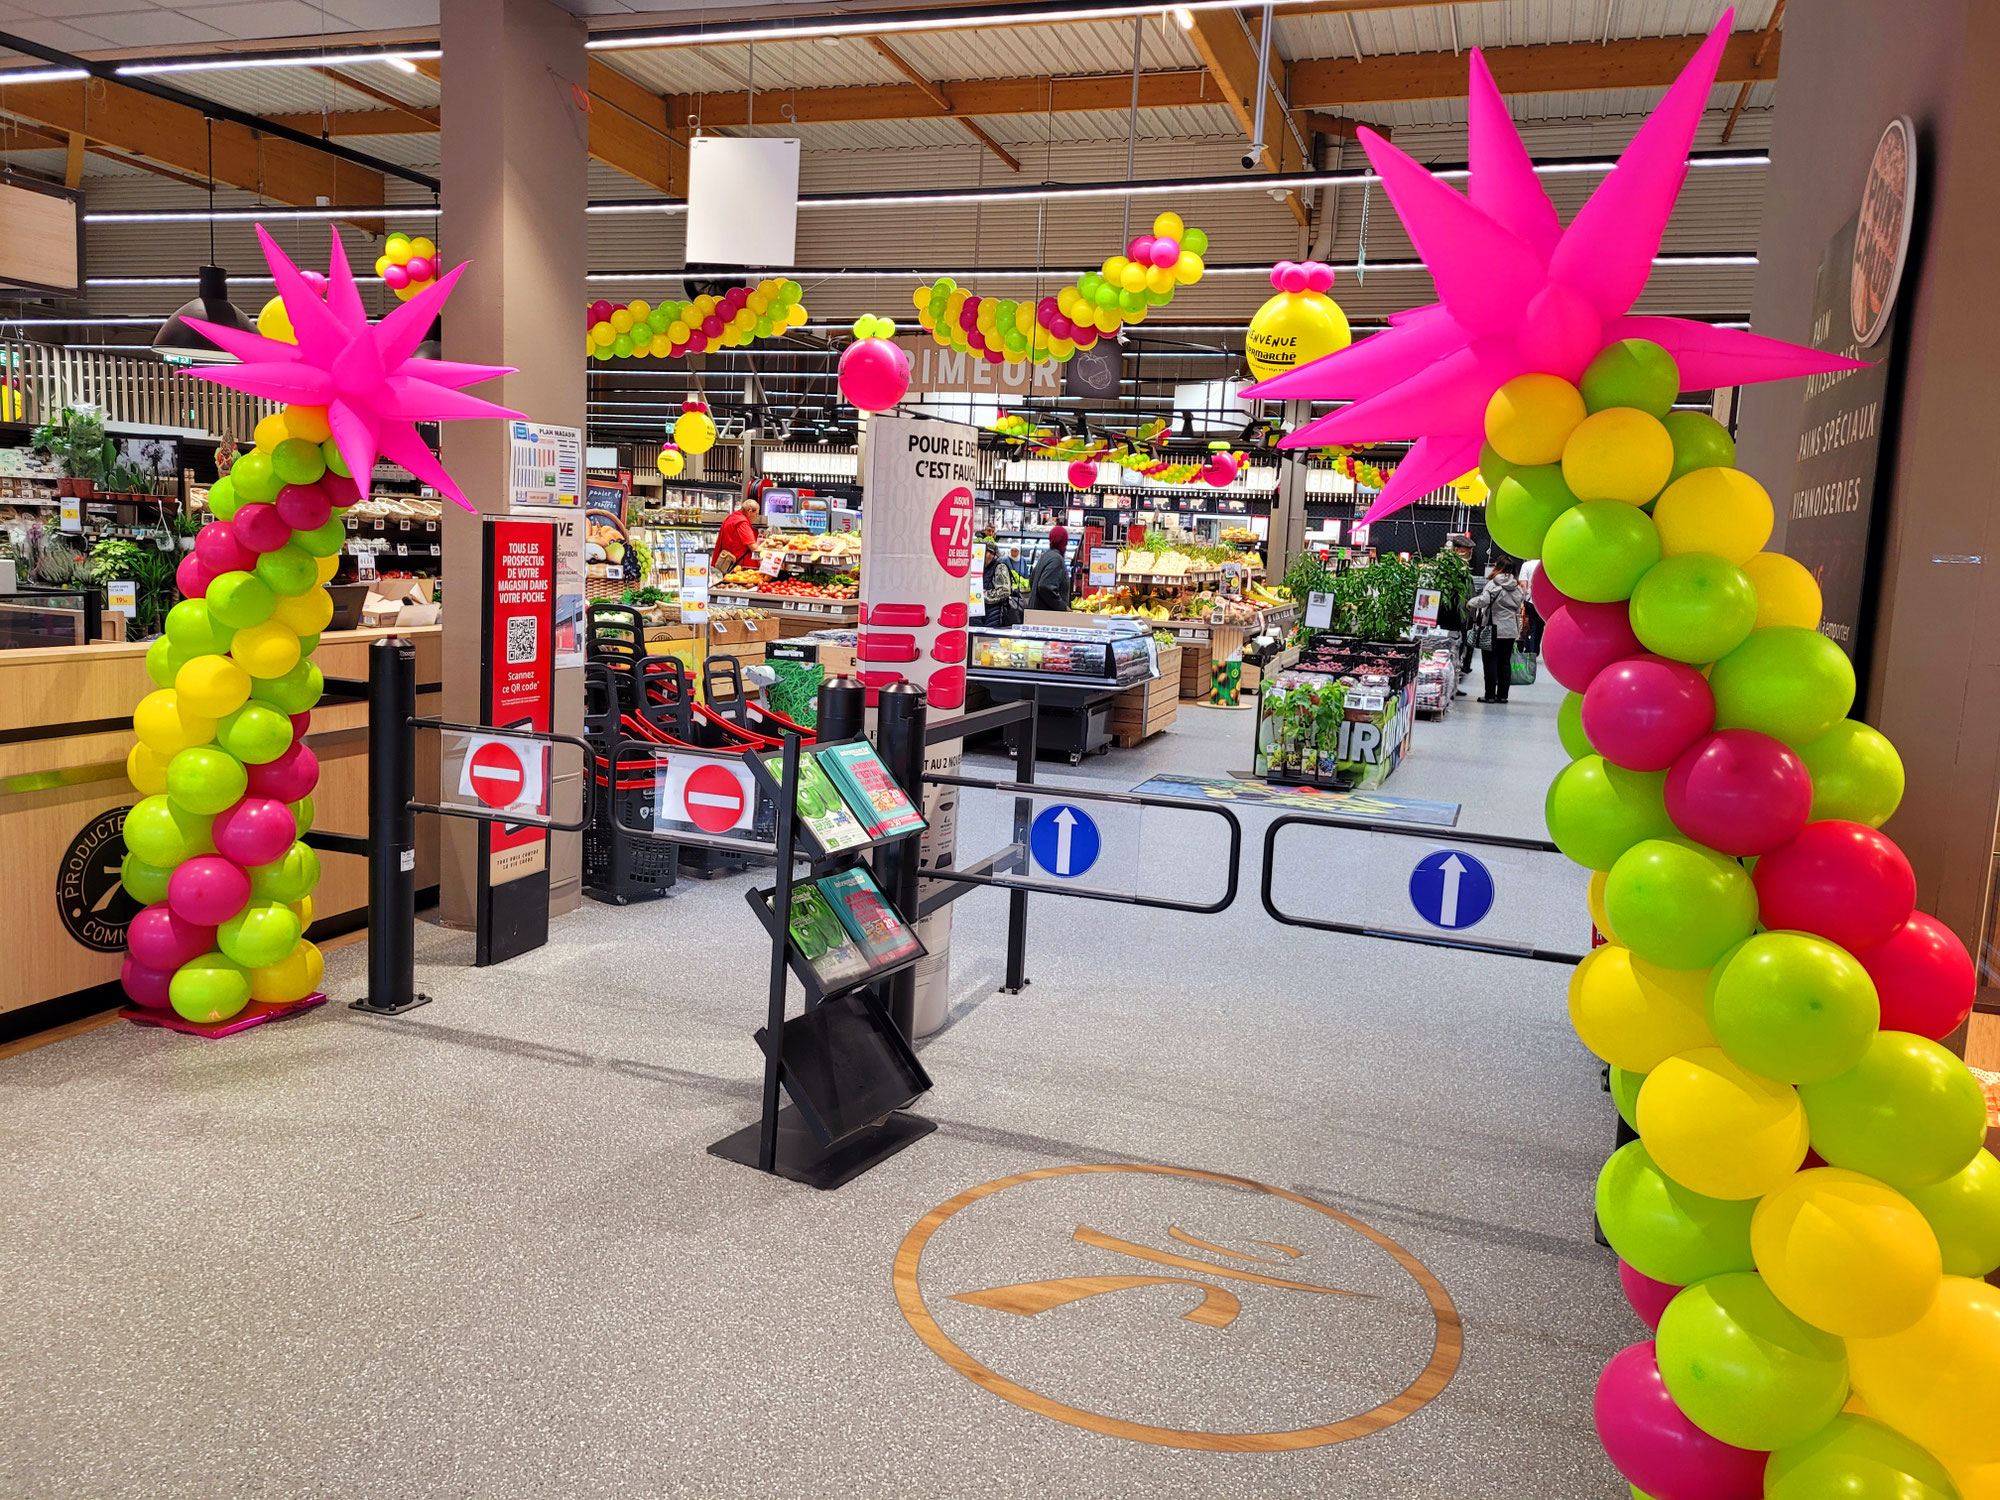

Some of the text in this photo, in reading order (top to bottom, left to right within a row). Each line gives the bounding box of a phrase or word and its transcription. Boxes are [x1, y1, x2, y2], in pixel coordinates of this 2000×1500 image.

[1248, 329, 1298, 348] IENVENUE
[903, 349, 1060, 388] RIMEUR
[1799, 402, 1877, 461] PAINS SPÉCIAUX
[908, 434, 976, 459] POUR LE DE
[915, 460, 951, 480] C’EST
[1792, 477, 1861, 521] VIENNOISERIES
[559, 522, 574, 537] VE
[508, 543, 539, 554] TOUS LES
[502, 555, 544, 567] PROSPECTUS
[507, 568, 539, 579] DE VOTRE
[498, 580, 548, 591] MAGASIN DANS
[499, 592, 546, 604] VOTRE POCHE.
[508, 671, 534, 681] Scannez
[502, 686, 509, 694] ce
[510, 683, 521, 694] QR
[1338, 720, 1381, 764] IR
[931, 759, 941, 770] AU
[943, 758, 947, 768] 2
[64, 814, 127, 899] PRODUCTE
[82, 921, 127, 944] COMM
